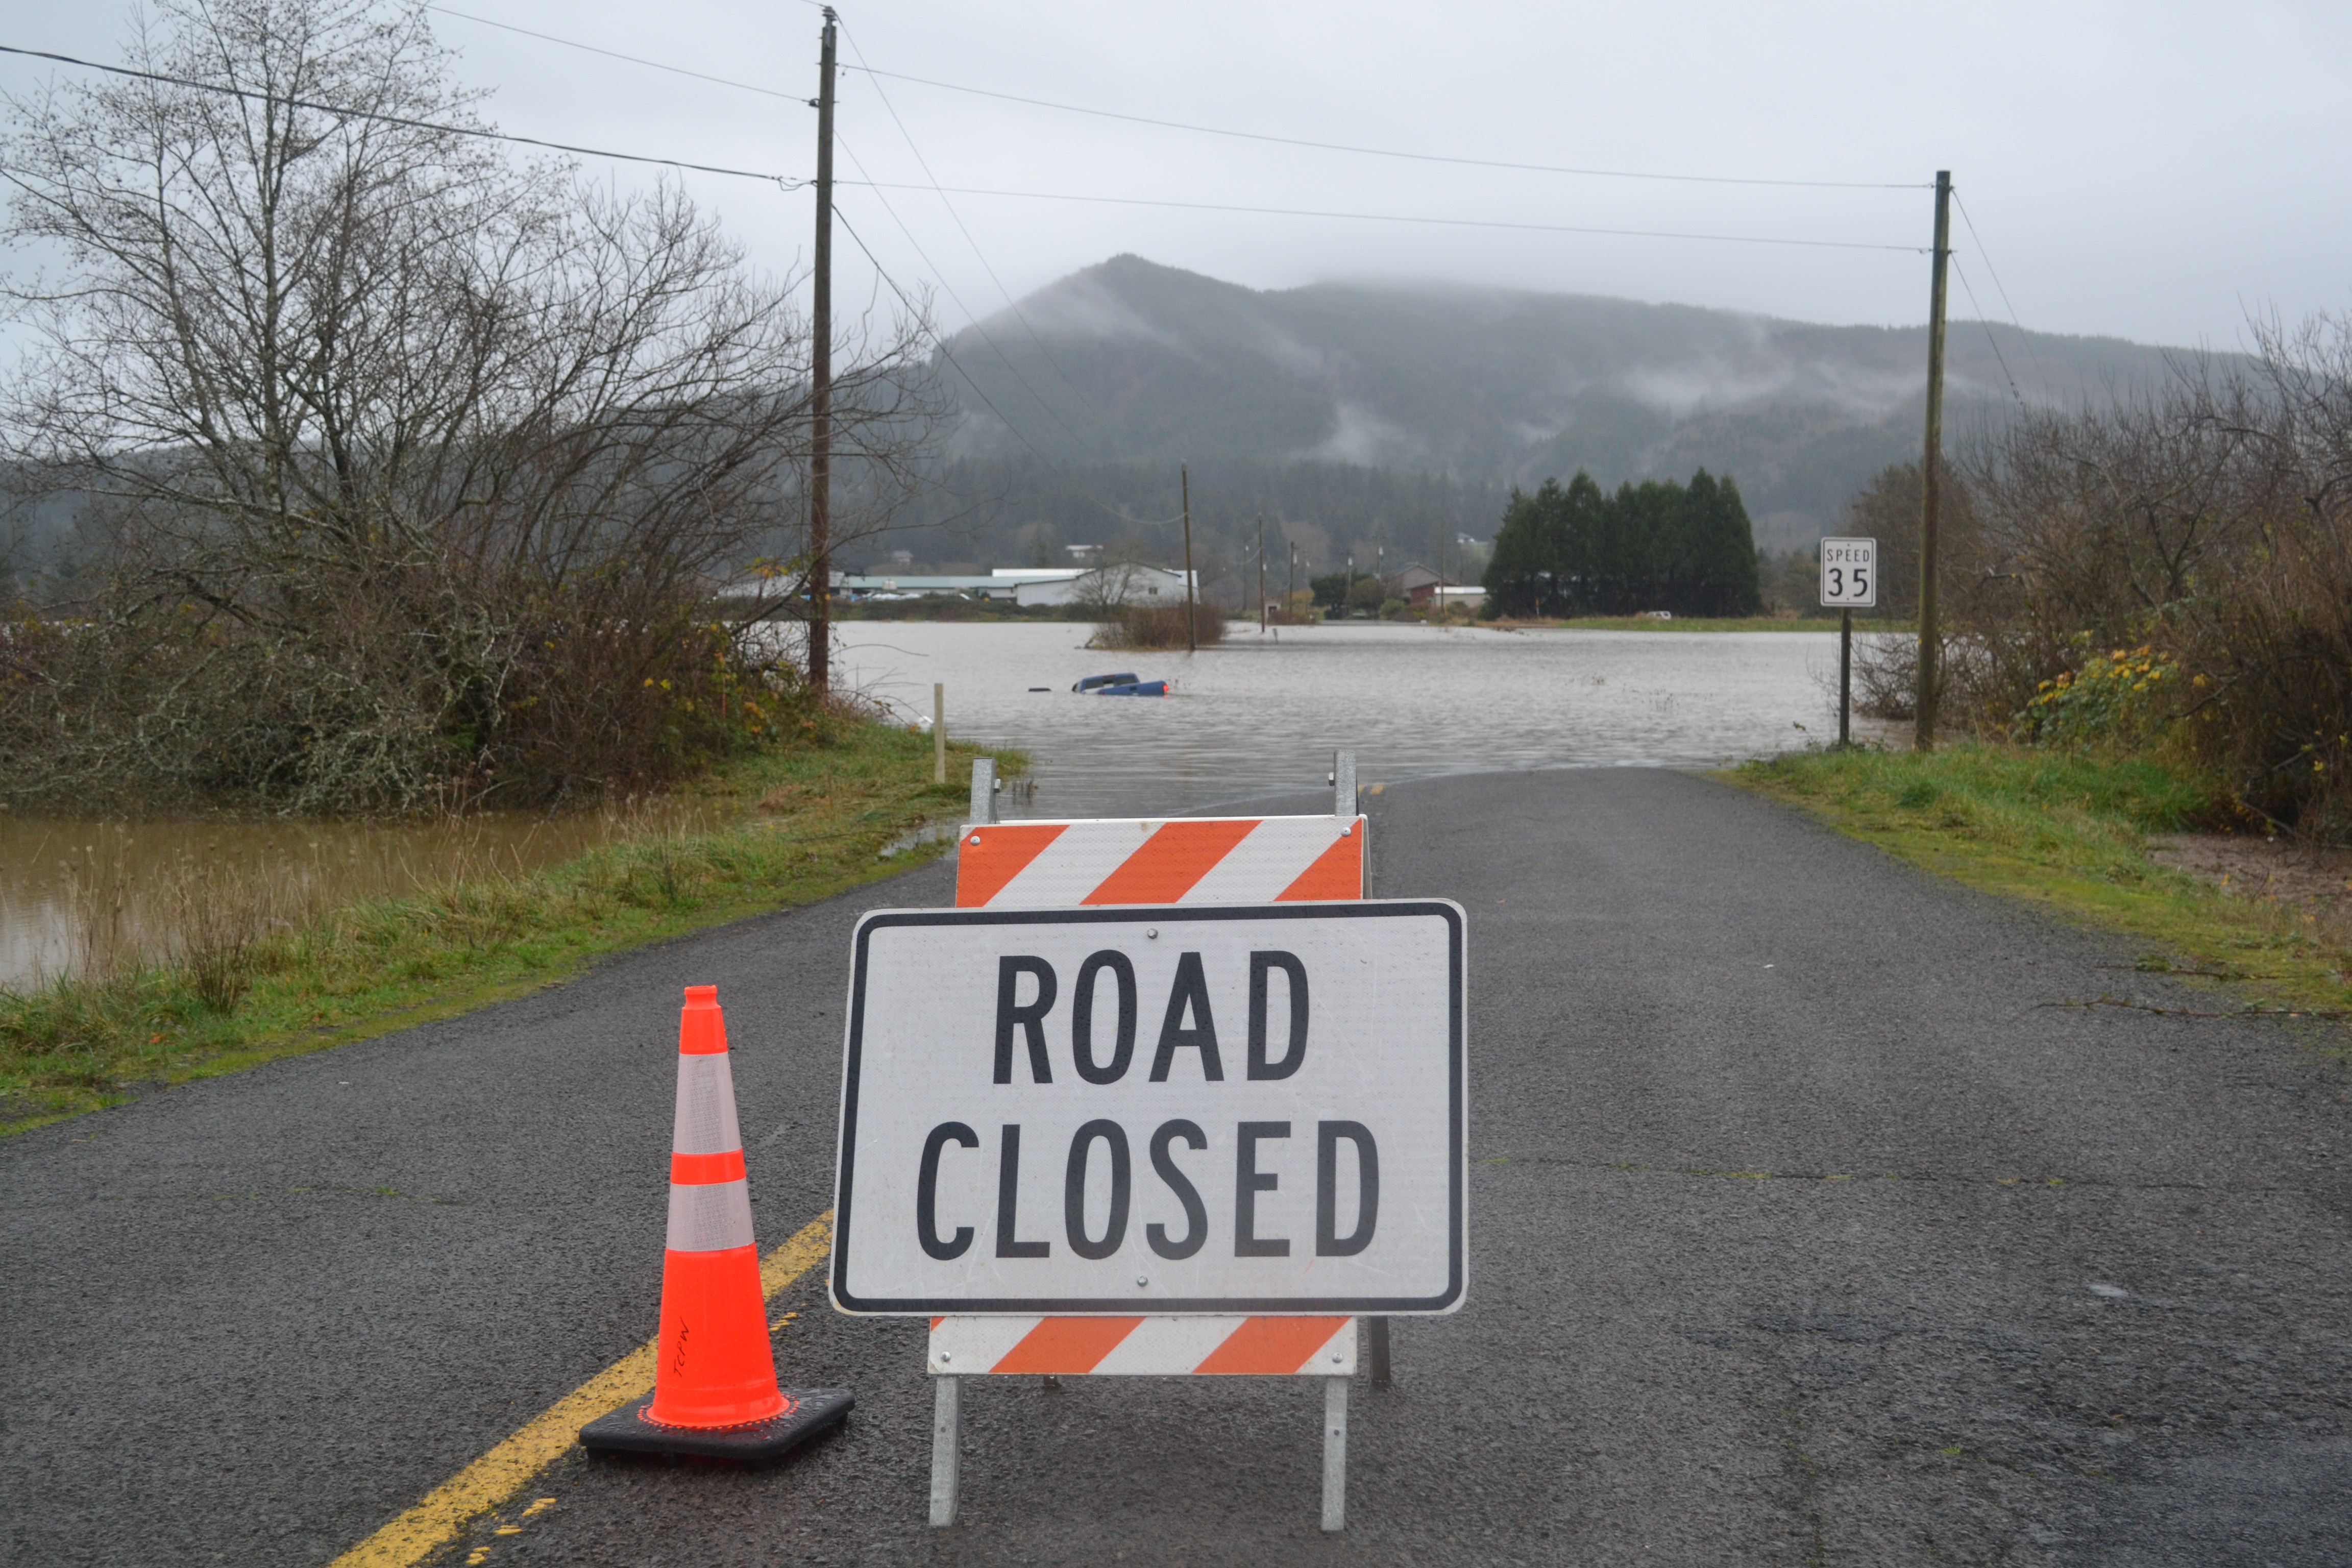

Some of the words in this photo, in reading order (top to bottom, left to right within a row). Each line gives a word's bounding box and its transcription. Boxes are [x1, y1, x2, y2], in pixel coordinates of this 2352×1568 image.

[1827, 549, 1870, 562] SPEED
[1828, 568, 1868, 597] 35
[993, 949, 1310, 1085] ROAD
[917, 1118, 1380, 1261] CLOSED
[673, 1316, 689, 1378] TCPW
